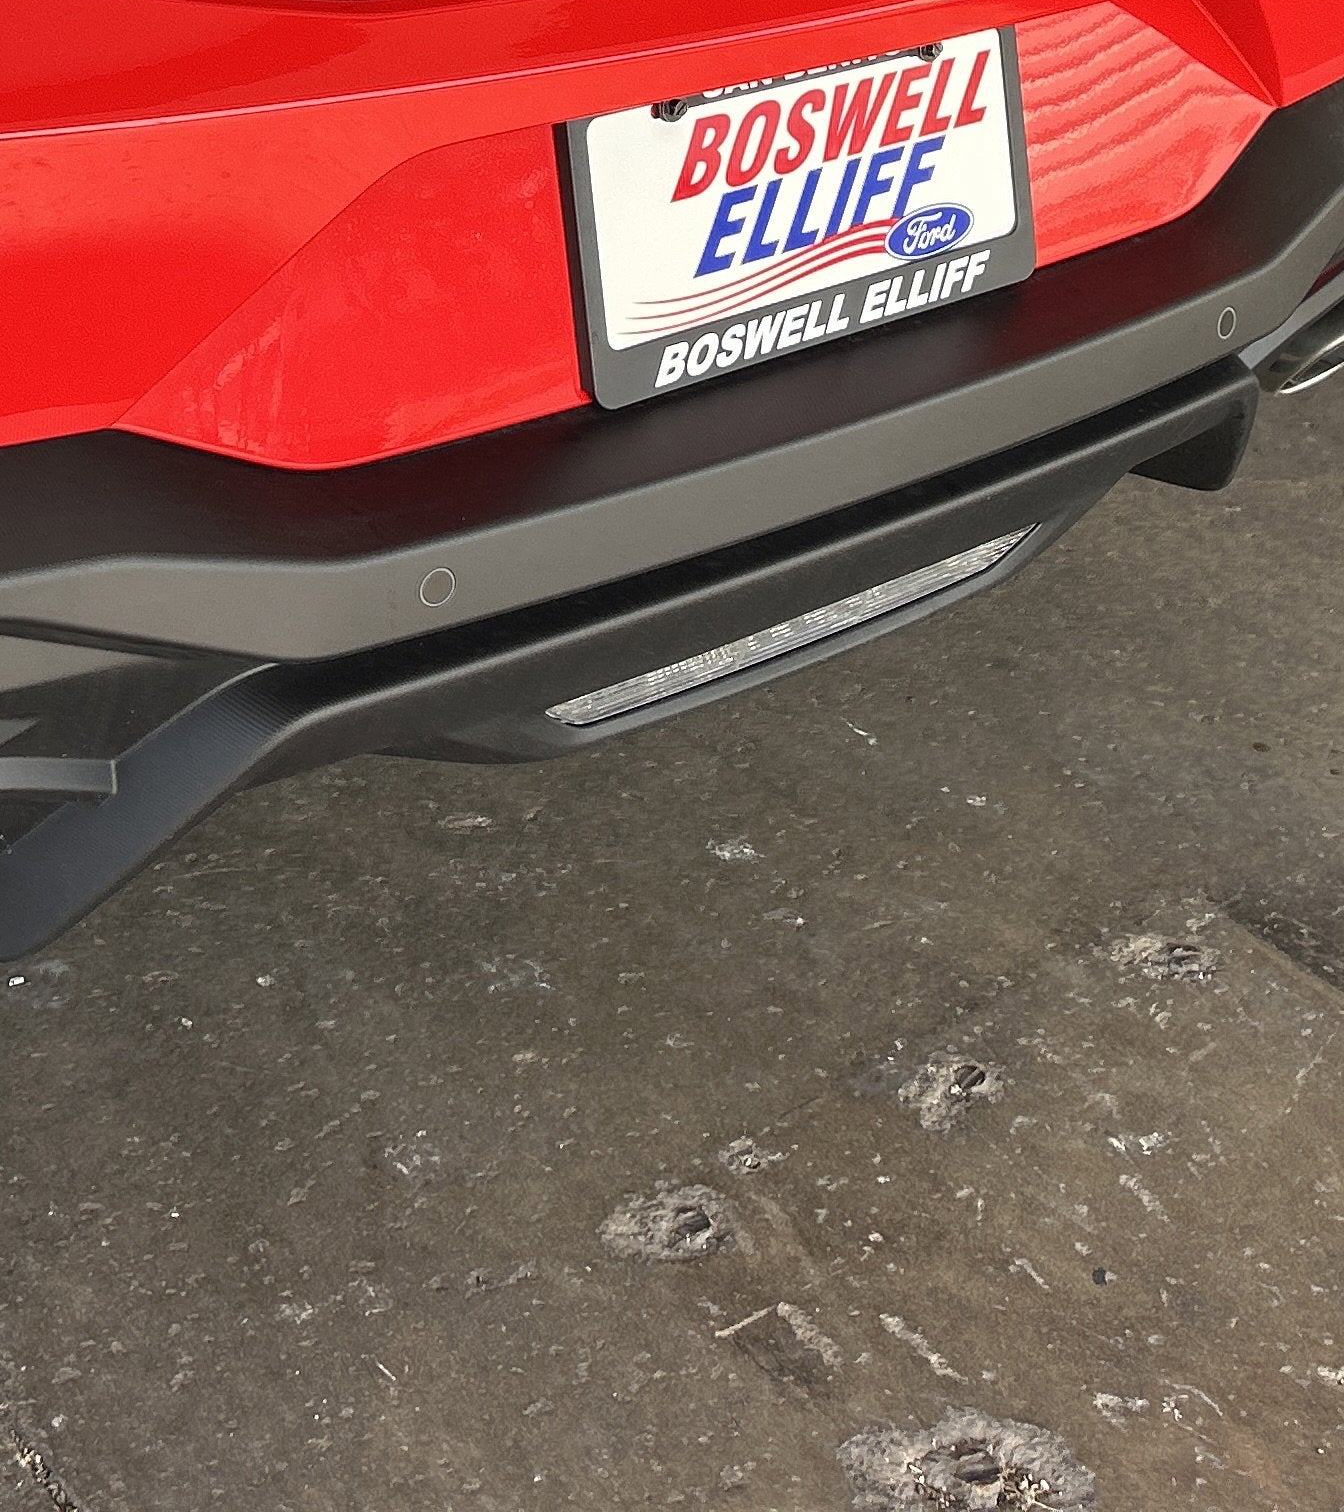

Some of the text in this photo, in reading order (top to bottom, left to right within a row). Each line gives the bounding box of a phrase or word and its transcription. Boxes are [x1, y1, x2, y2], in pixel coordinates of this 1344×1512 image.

[670, 50, 992, 204] BOSWELL
[693, 134, 947, 279] ELLIFF
[902, 216, 958, 255] Ford
[654, 249, 991, 388] BOSWELL ELLIFF
